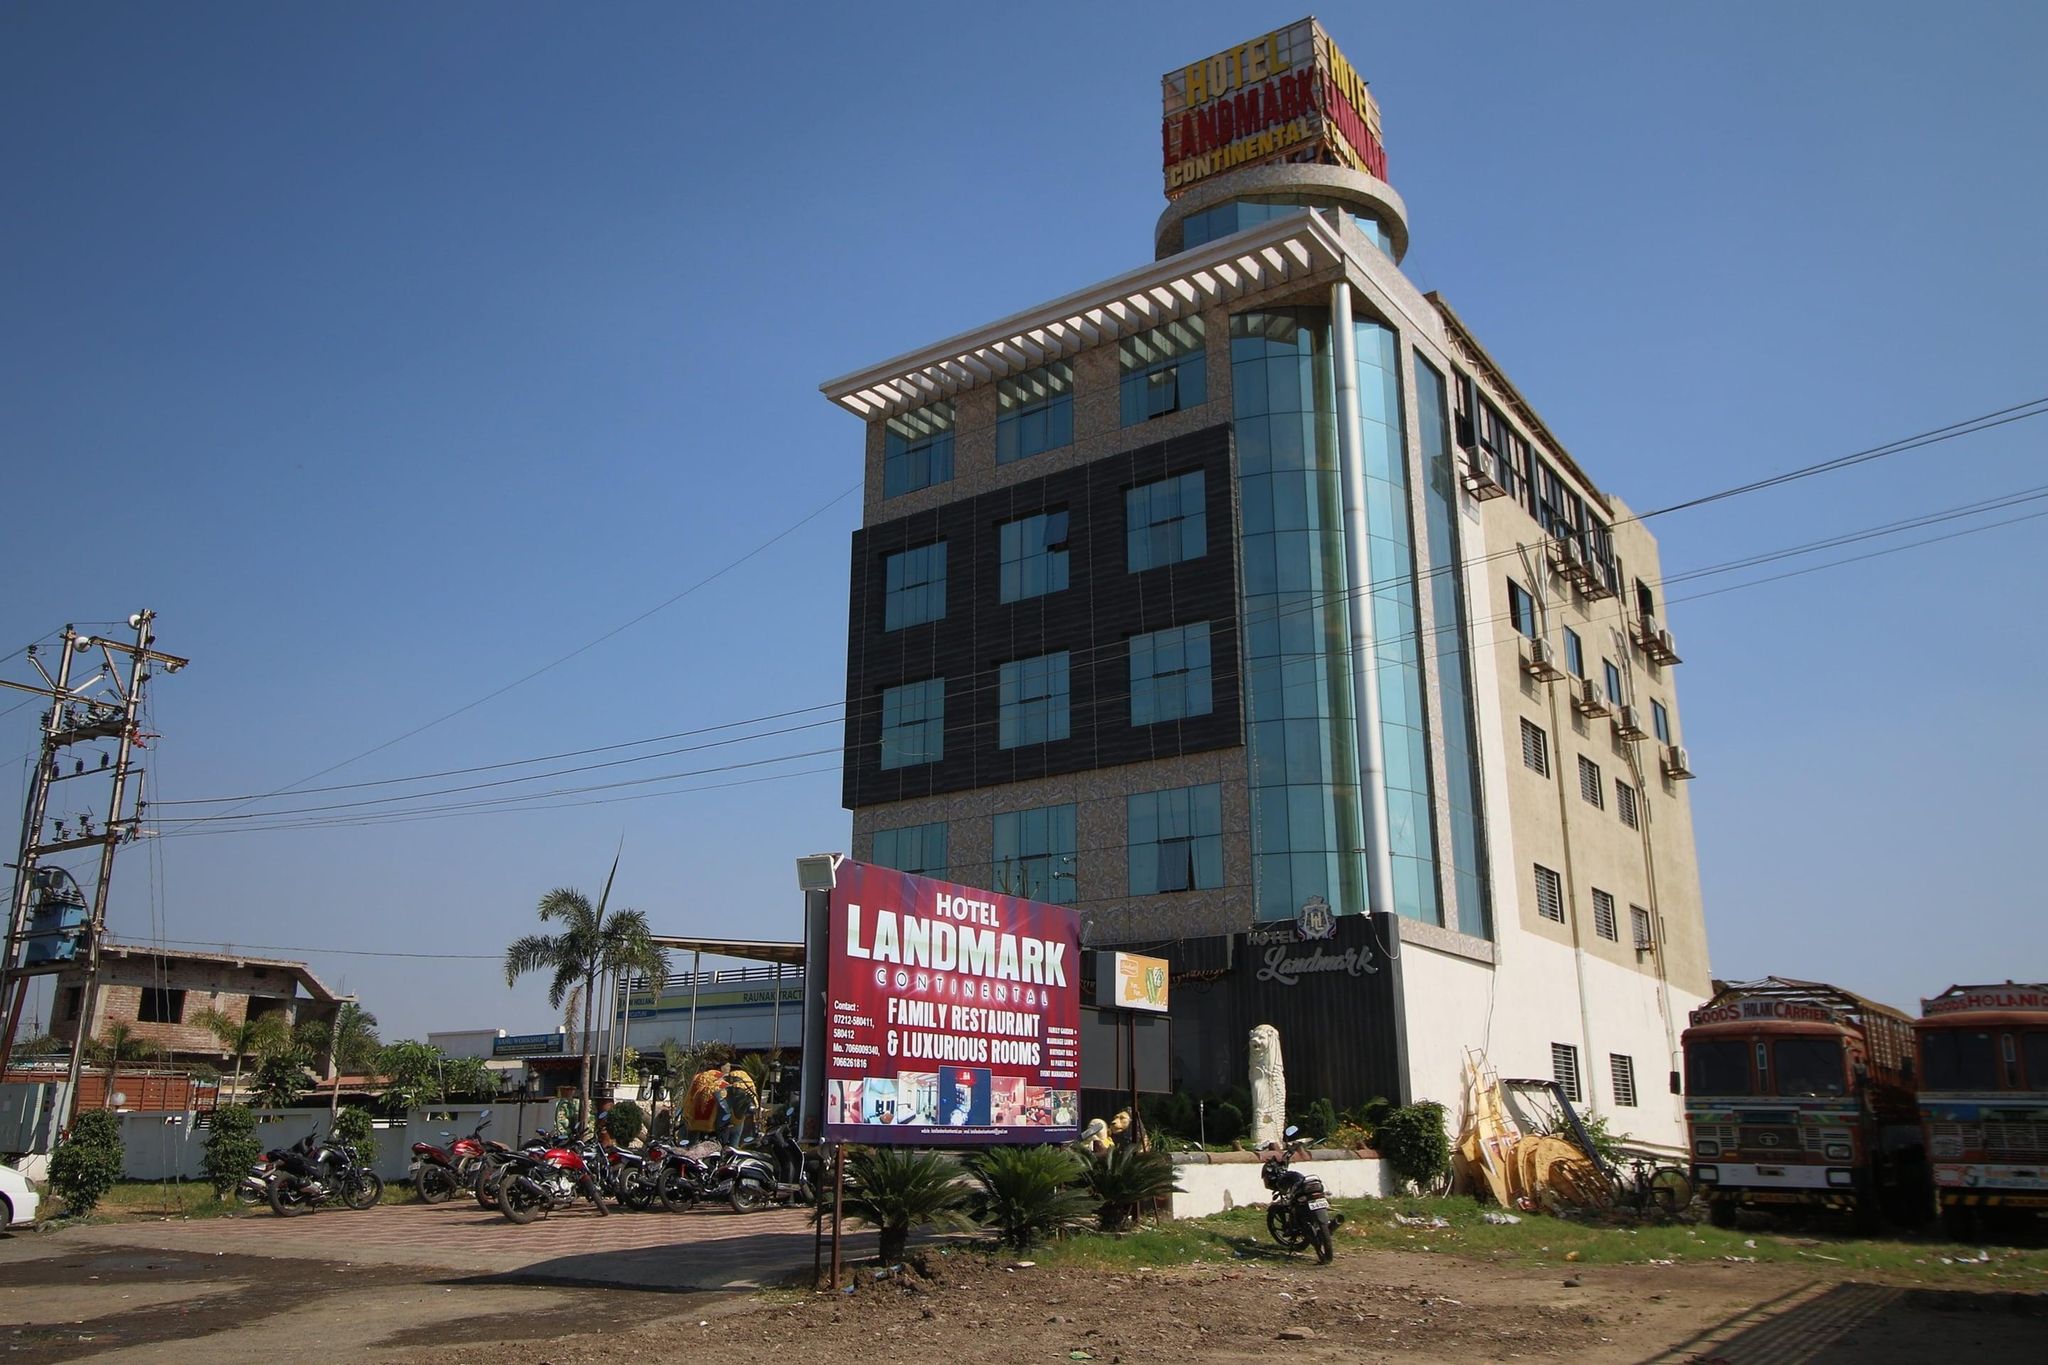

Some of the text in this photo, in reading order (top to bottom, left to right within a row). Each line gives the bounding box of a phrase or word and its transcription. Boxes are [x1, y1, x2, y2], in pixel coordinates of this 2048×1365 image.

[1185, 31, 1290, 107] HOTEL
[1162, 64, 1317, 168] LANDMARK
[1322, 69, 1387, 183] LANDMARK
[1169, 116, 1313, 187] CONTINENTAL
[936, 892, 1000, 928] HOTEL
[846, 903, 1067, 988] LANDMARK
[1246, 929, 1299, 945] HOTEL
[1256, 945, 1378, 985] Landmark
[743, 991, 776, 1002] RAUNAK
[834, 1000, 856, 1011] Contact
[875, 968, 1049, 1006] CONTINENTAL
[888, 997, 1040, 1037] FAMILY RESTAURANT
[1693, 1004, 1741, 1024] GOODS
[1774, 1001, 1830, 1021] CARRIER
[887, 1030, 1041, 1066] & LUXURIOUS ROOMS
